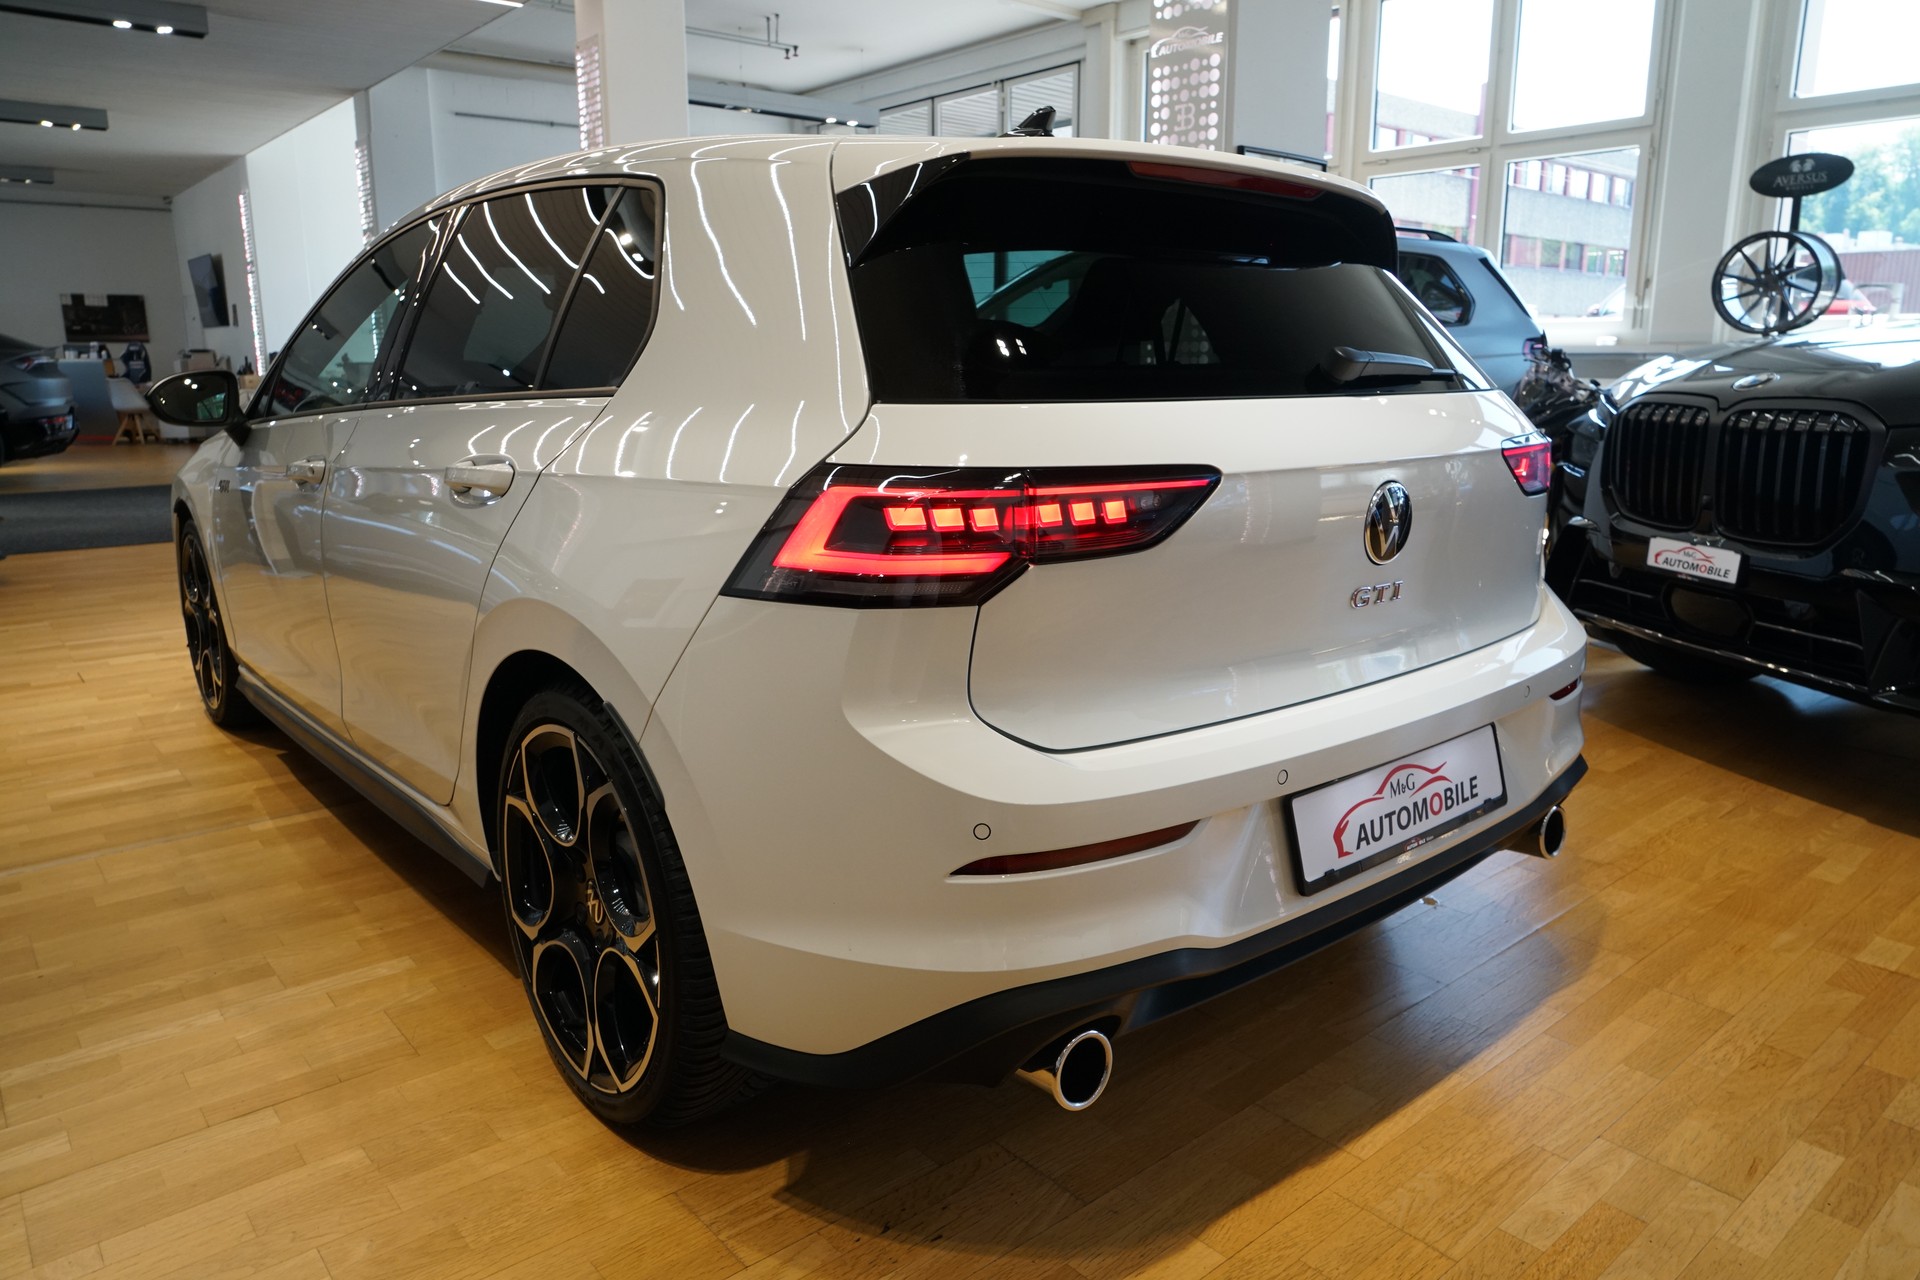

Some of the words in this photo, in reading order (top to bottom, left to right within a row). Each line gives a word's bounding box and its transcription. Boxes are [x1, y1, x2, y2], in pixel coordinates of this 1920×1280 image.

[1158, 32, 1224, 57] AUTOMOBILE
[1773, 171, 1828, 188] AVERSUS
[1662, 557, 1731, 579] AUTOMOBILE
[1351, 580, 1404, 609] GTI
[1390, 773, 1415, 798] M&G
[1356, 776, 1479, 850] AUTOMOBILE
